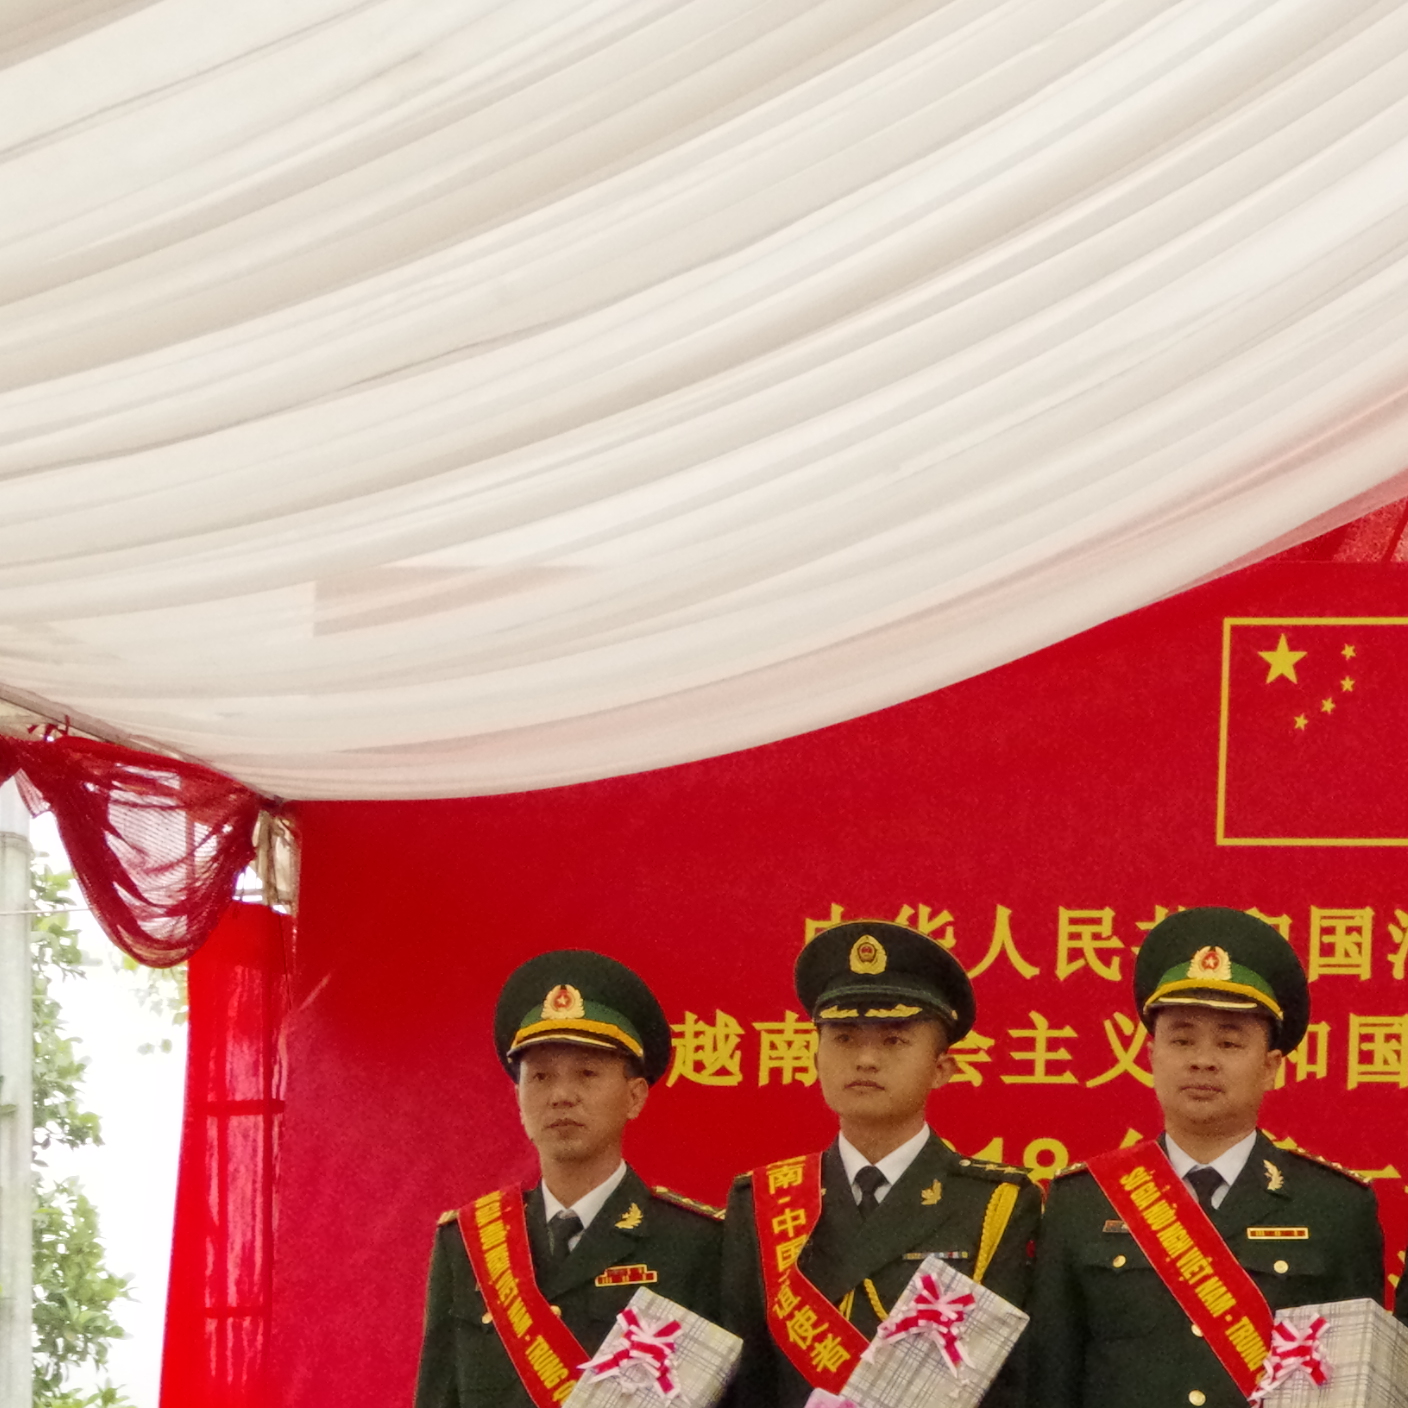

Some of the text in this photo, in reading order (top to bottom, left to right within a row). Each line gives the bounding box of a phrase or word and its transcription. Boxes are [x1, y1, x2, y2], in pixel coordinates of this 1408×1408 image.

[1176, 1247, 1214, 1285] VIỆT
[1194, 1276, 1237, 1318] NAM
[507, 1297, 533, 1338] NAM
[525, 1335, 569, 1389] TRUNG
[1225, 1316, 1269, 1372] TRUNG
